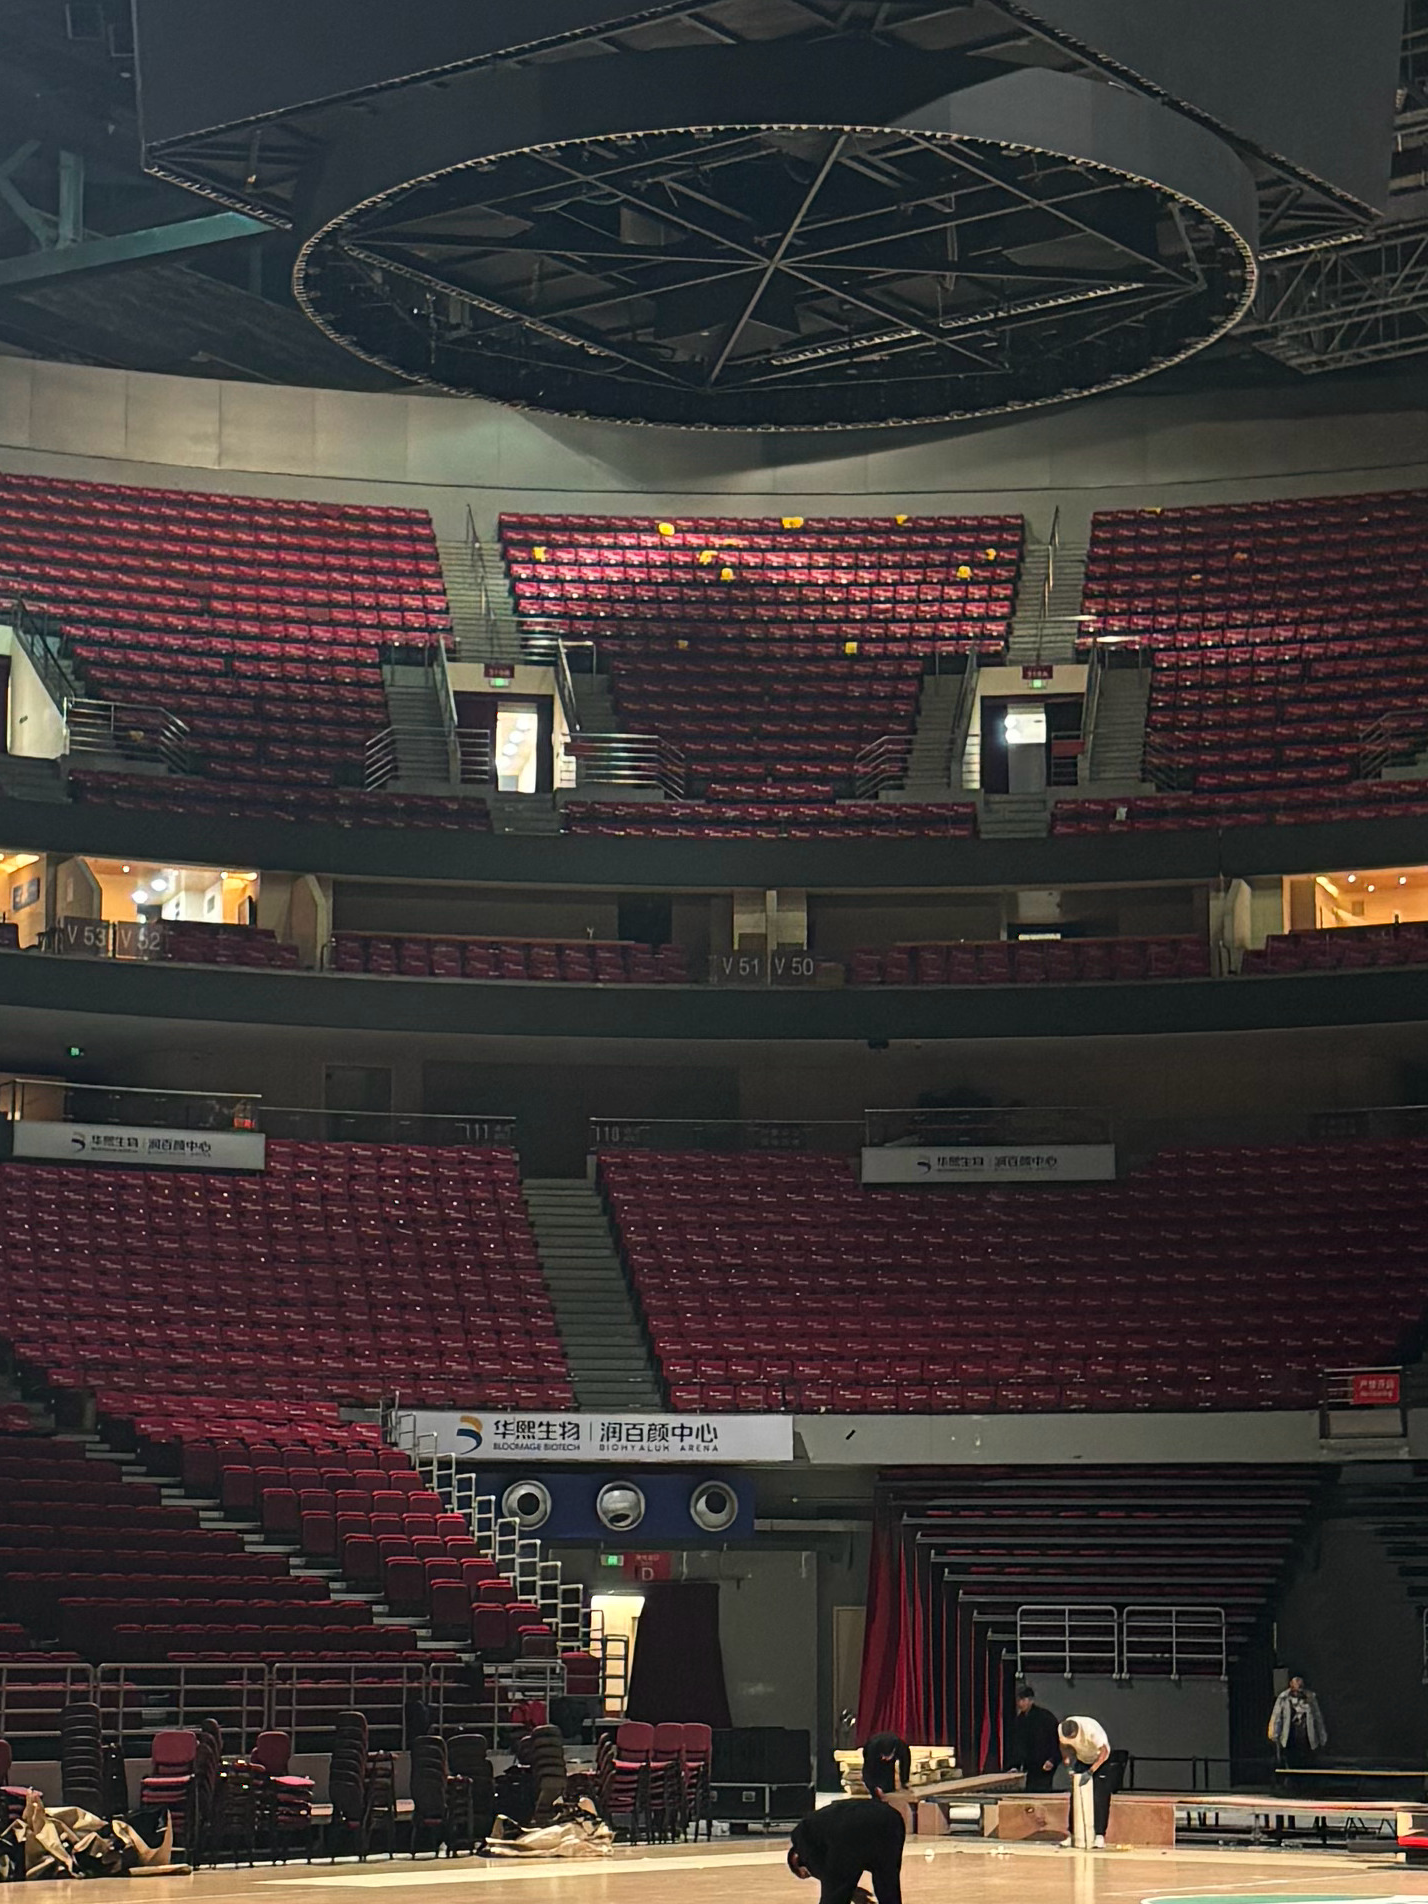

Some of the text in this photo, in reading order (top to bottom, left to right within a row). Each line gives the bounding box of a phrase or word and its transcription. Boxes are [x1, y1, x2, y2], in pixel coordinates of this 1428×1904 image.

[67, 925, 106, 947] V 53
[120, 929, 160, 950] V 52
[721, 957, 759, 976] V 51
[774, 957, 814, 976] V 50
[466, 1124, 488, 1140] 111
[595, 1125, 619, 1142] 110
[492, 1420, 581, 1442] 华熙生物
[599, 1421, 719, 1443] 润百颜中心
[642, 1567, 654, 1581] D
